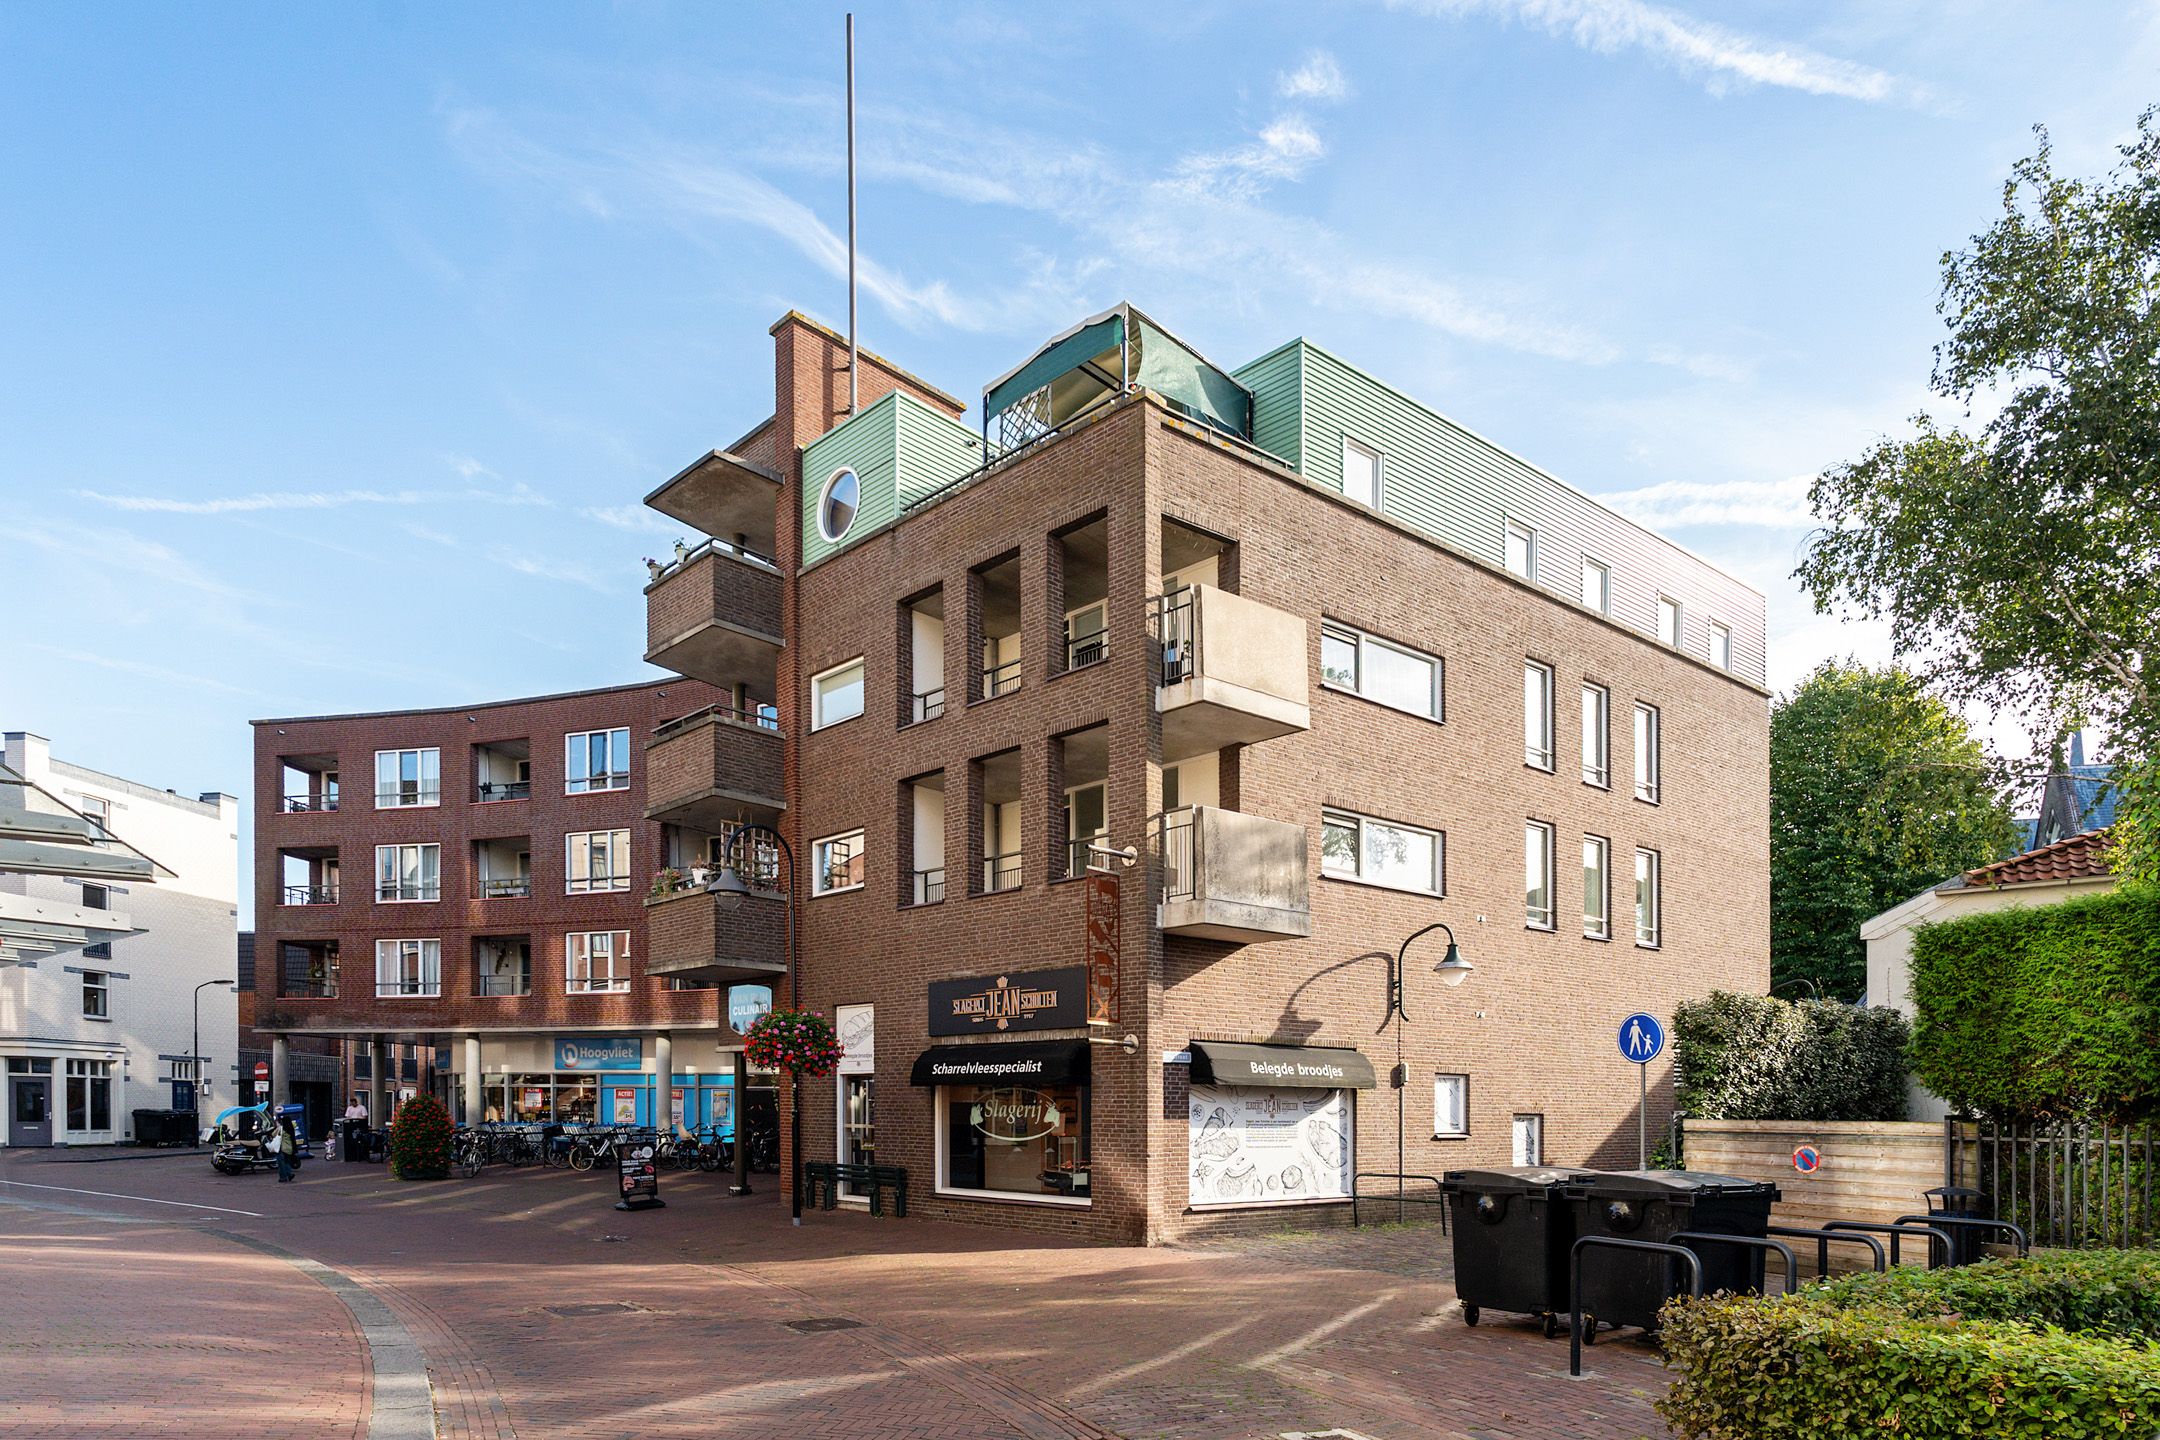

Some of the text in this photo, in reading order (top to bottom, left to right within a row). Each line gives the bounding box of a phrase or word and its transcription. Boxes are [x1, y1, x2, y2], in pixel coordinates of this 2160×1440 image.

[733, 1003, 768, 1016] CULINAIR
[952, 989, 1058, 1017] SLAGERIJ JEAN SCHOLTEN
[579, 1046, 633, 1060] Hoogvliet
[932, 1060, 1043, 1076] Scharrelvleesspecialist
[1250, 1061, 1344, 1080] Belegde broodjes
[984, 1099, 1043, 1125] Slagerij
[1264, 1099, 1281, 1113] JEAN
